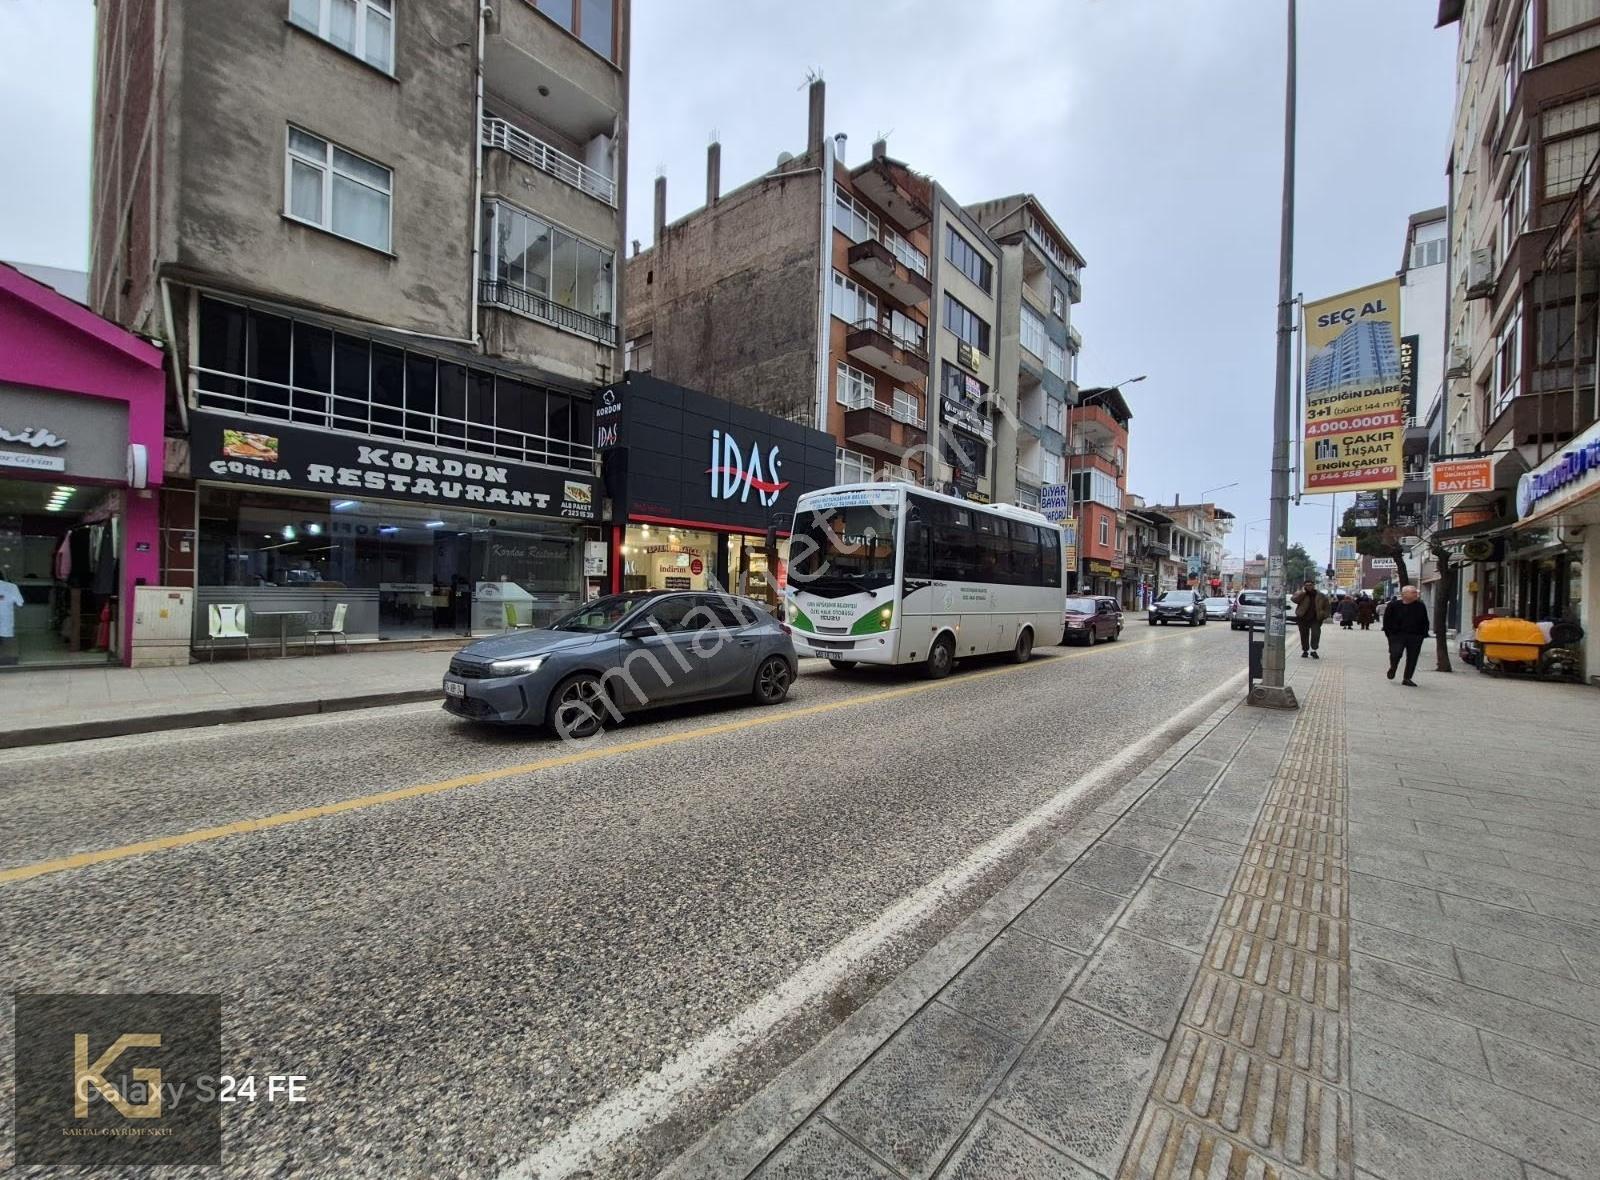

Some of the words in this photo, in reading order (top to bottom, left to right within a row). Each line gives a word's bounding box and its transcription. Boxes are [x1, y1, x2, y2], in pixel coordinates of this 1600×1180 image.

[1318, 307, 1356, 328] SEÇ
[1360, 299, 1387, 318] AL
[1364, 384, 1400, 397] DAİRE
[596, 402, 622, 417] KORDON
[1307, 406, 1332, 419] 3+1
[1307, 414, 1399, 435] 4.000.000TL
[1343, 431, 1394, 447] ÇAKIR
[209, 460, 292, 481] ÇORBA
[357, 446, 508, 484] KORDON
[1316, 460, 1350, 471] ENGİN
[1352, 457, 1388, 469] ÇAKIR
[306, 463, 550, 509] RESTAURANT
[1437, 476, 1487, 491] BAYİSİ
[573, 503, 592, 511] PAKET
[1042, 497, 1066, 509] BAYAN
